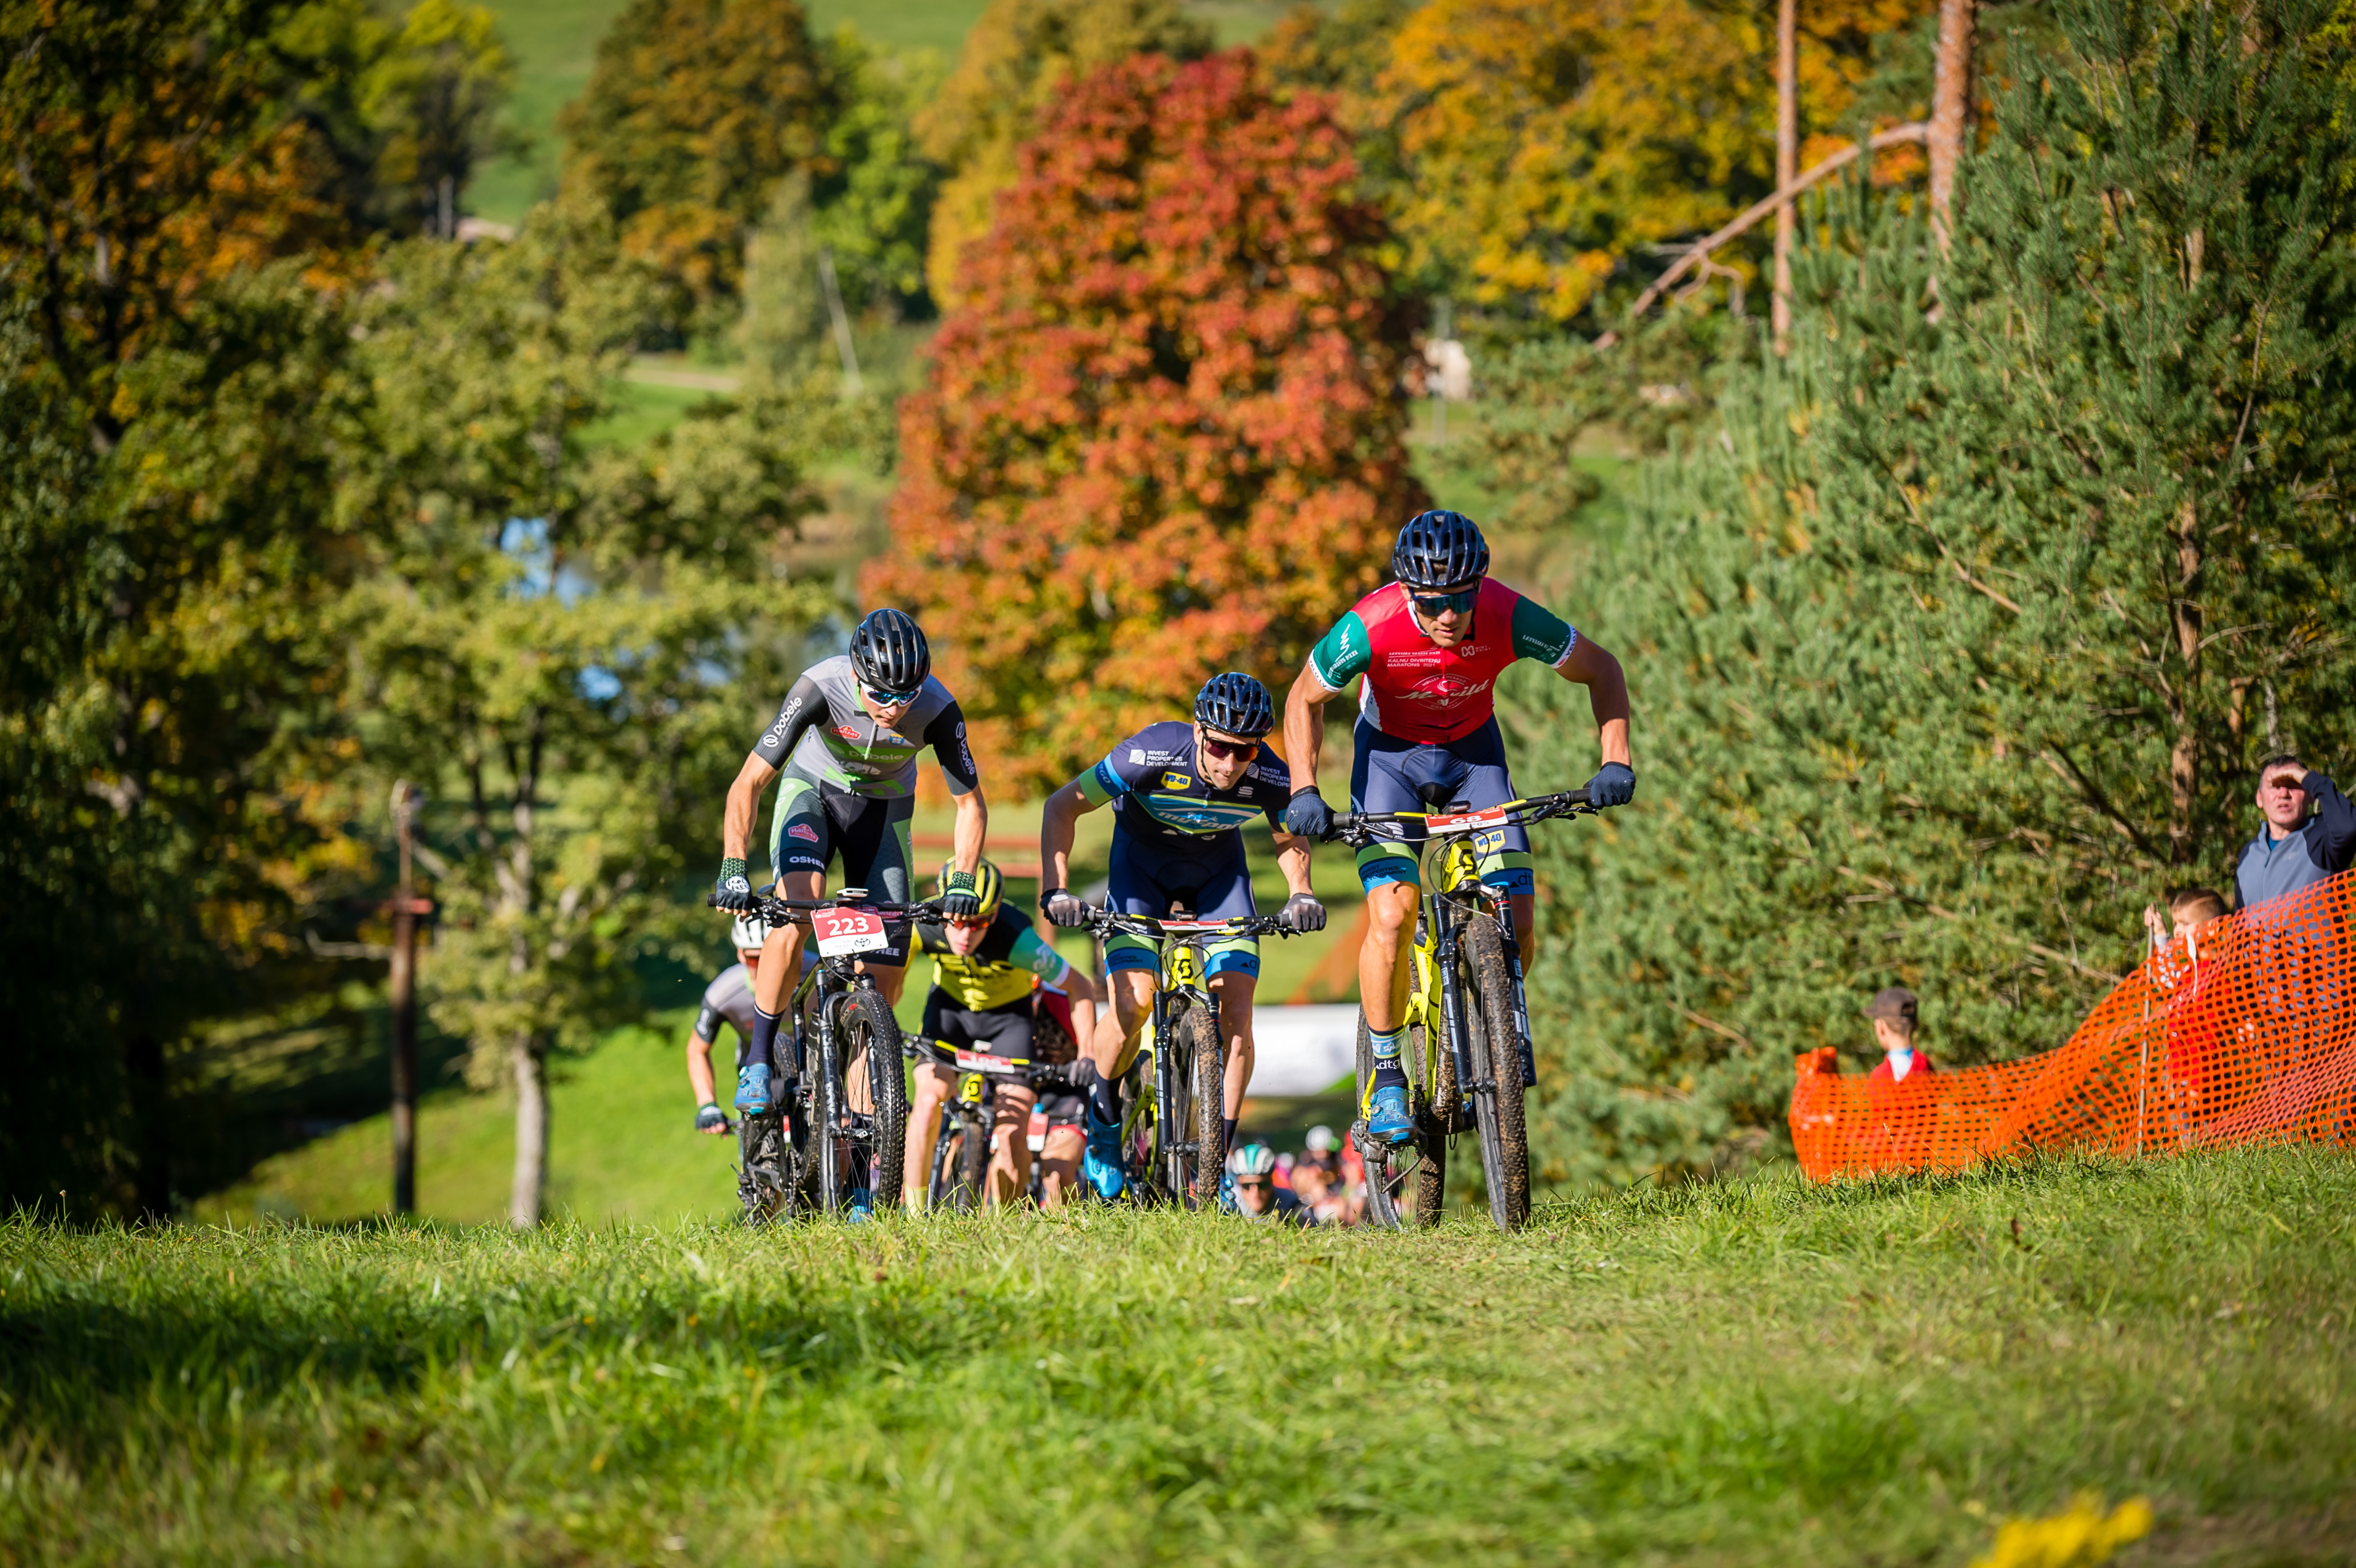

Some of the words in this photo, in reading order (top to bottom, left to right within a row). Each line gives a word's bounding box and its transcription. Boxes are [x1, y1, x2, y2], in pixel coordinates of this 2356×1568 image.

[773, 697, 802, 736] Dobele
[960, 736, 975, 775] Dobele
[1261, 766, 1280, 774] INVEST
[1165, 774, 1188, 785] WD-40
[1450, 815, 1482, 824] 68
[827, 917, 869, 936] 223
[1379, 1059, 1400, 1069] dtg
